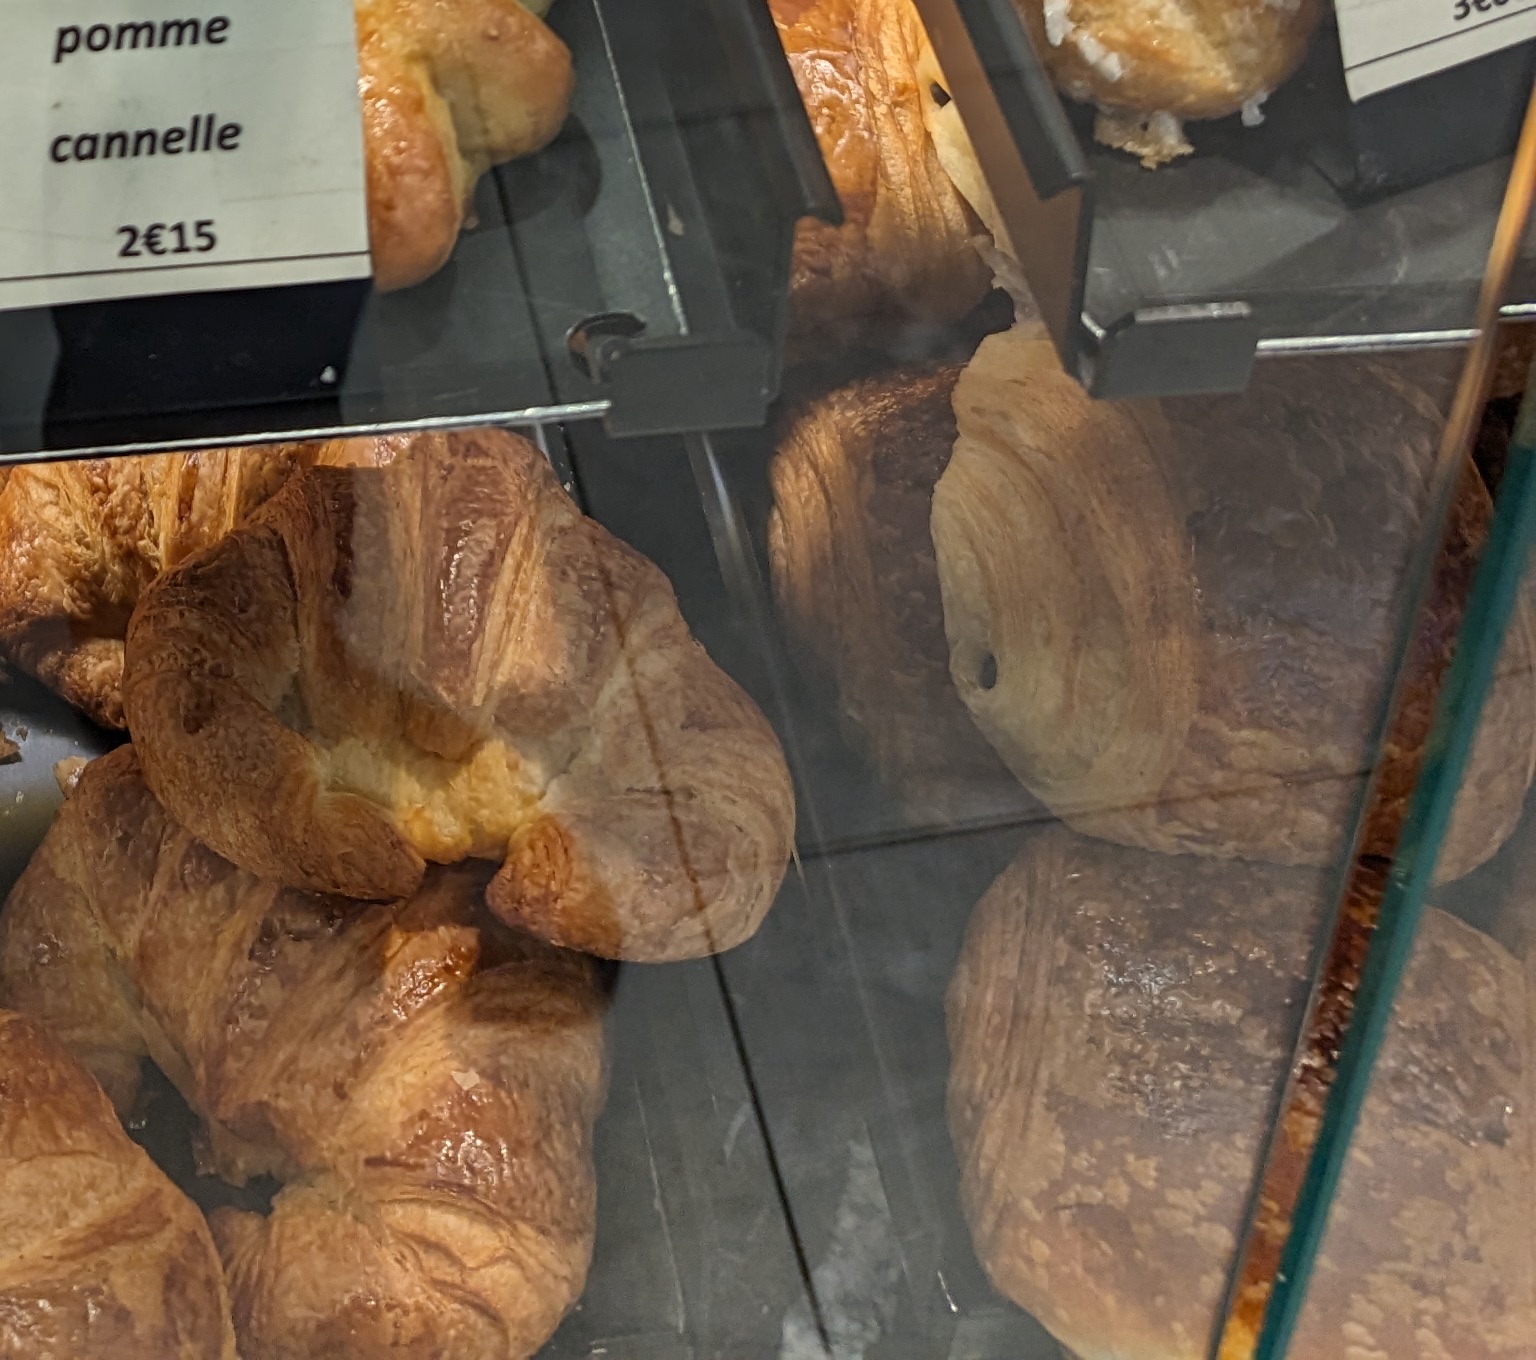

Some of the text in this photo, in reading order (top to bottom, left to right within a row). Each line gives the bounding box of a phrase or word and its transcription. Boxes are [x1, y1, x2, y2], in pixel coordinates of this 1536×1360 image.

[53, 15, 231, 64] pomme
[49, 112, 243, 164] cannelle
[116, 219, 218, 258] 2€15
